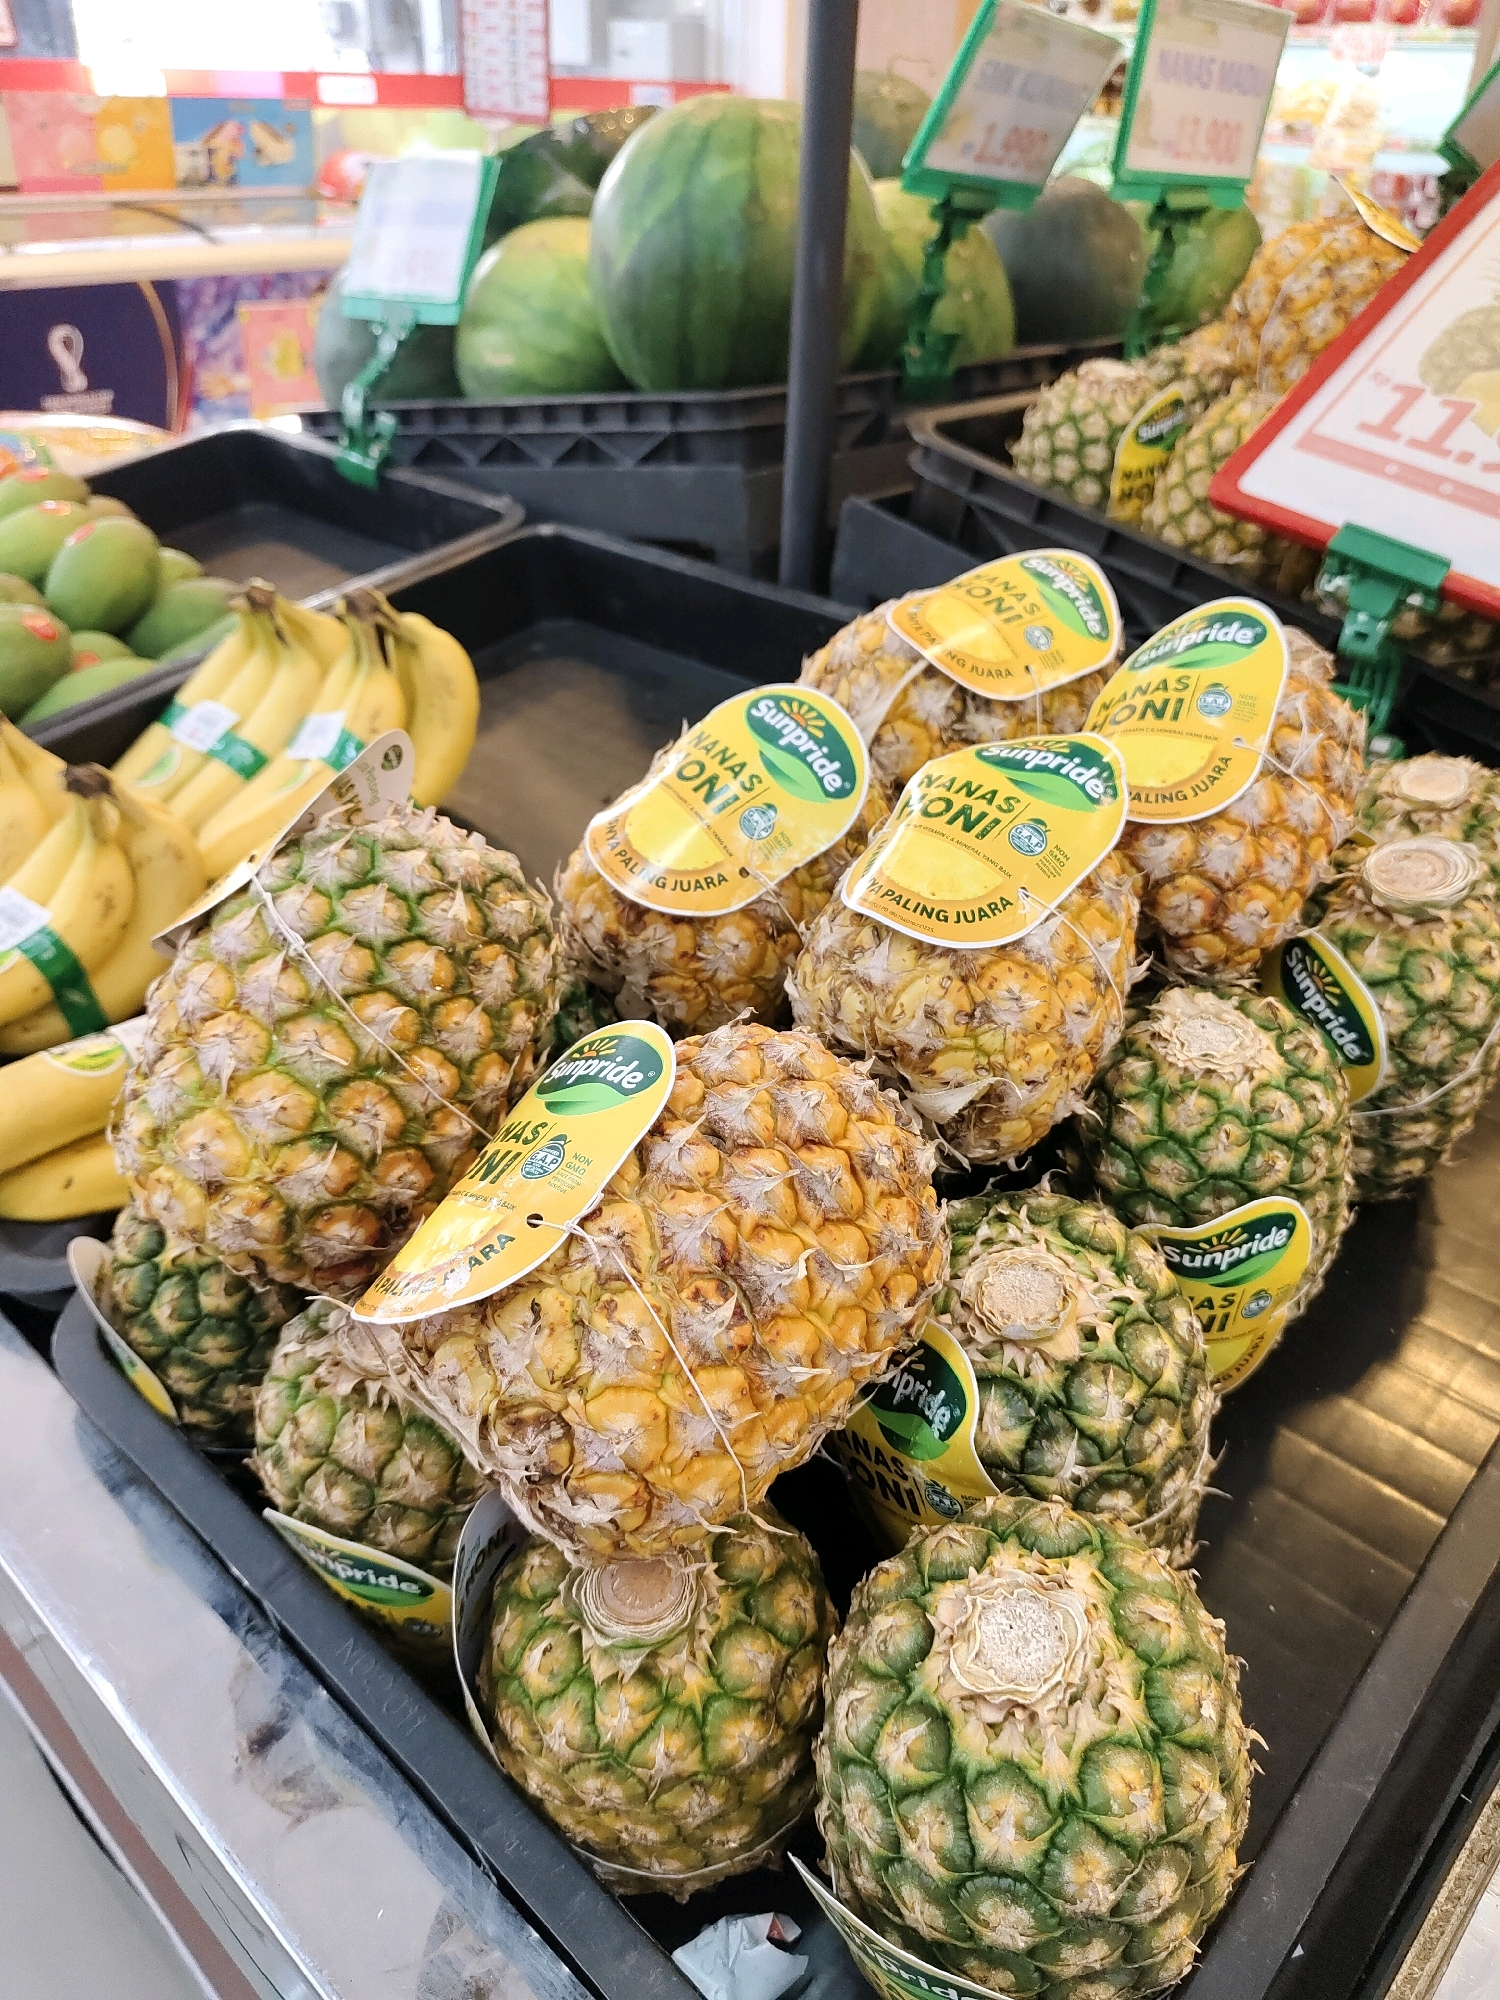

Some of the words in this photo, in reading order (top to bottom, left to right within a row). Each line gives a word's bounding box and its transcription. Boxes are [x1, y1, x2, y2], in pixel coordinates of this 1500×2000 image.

[968, 665, 1014, 680] JUARA
[1097, 675, 1192, 716] NANAS
[688, 730, 763, 793] NANAS
[750, 697, 844, 794] Sunpride
[675, 748, 741, 816] ONI
[981, 743, 1105, 799] Sunpride
[1190, 755, 1232, 798] JUARA
[918, 773, 1021, 815] NANAS
[615, 849, 669, 890] PALING
[670, 872, 729, 892] JUARA
[1048, 849, 1066, 868] GMO
[1053, 844, 1071, 861] NON
[880, 888, 949, 924] PALING
[953, 896, 1014, 925] JUARA
[1285, 946, 1363, 1061] Sunpride
[543, 1055, 645, 1089] Sunpride
[565, 1161, 587, 1176] GMO
[571, 1151, 594, 1167] NON
[1163, 1225, 1290, 1272] Sunpride
[835, 1429, 910, 1482] ANAS
[850, 1455, 922, 1517] ONI
